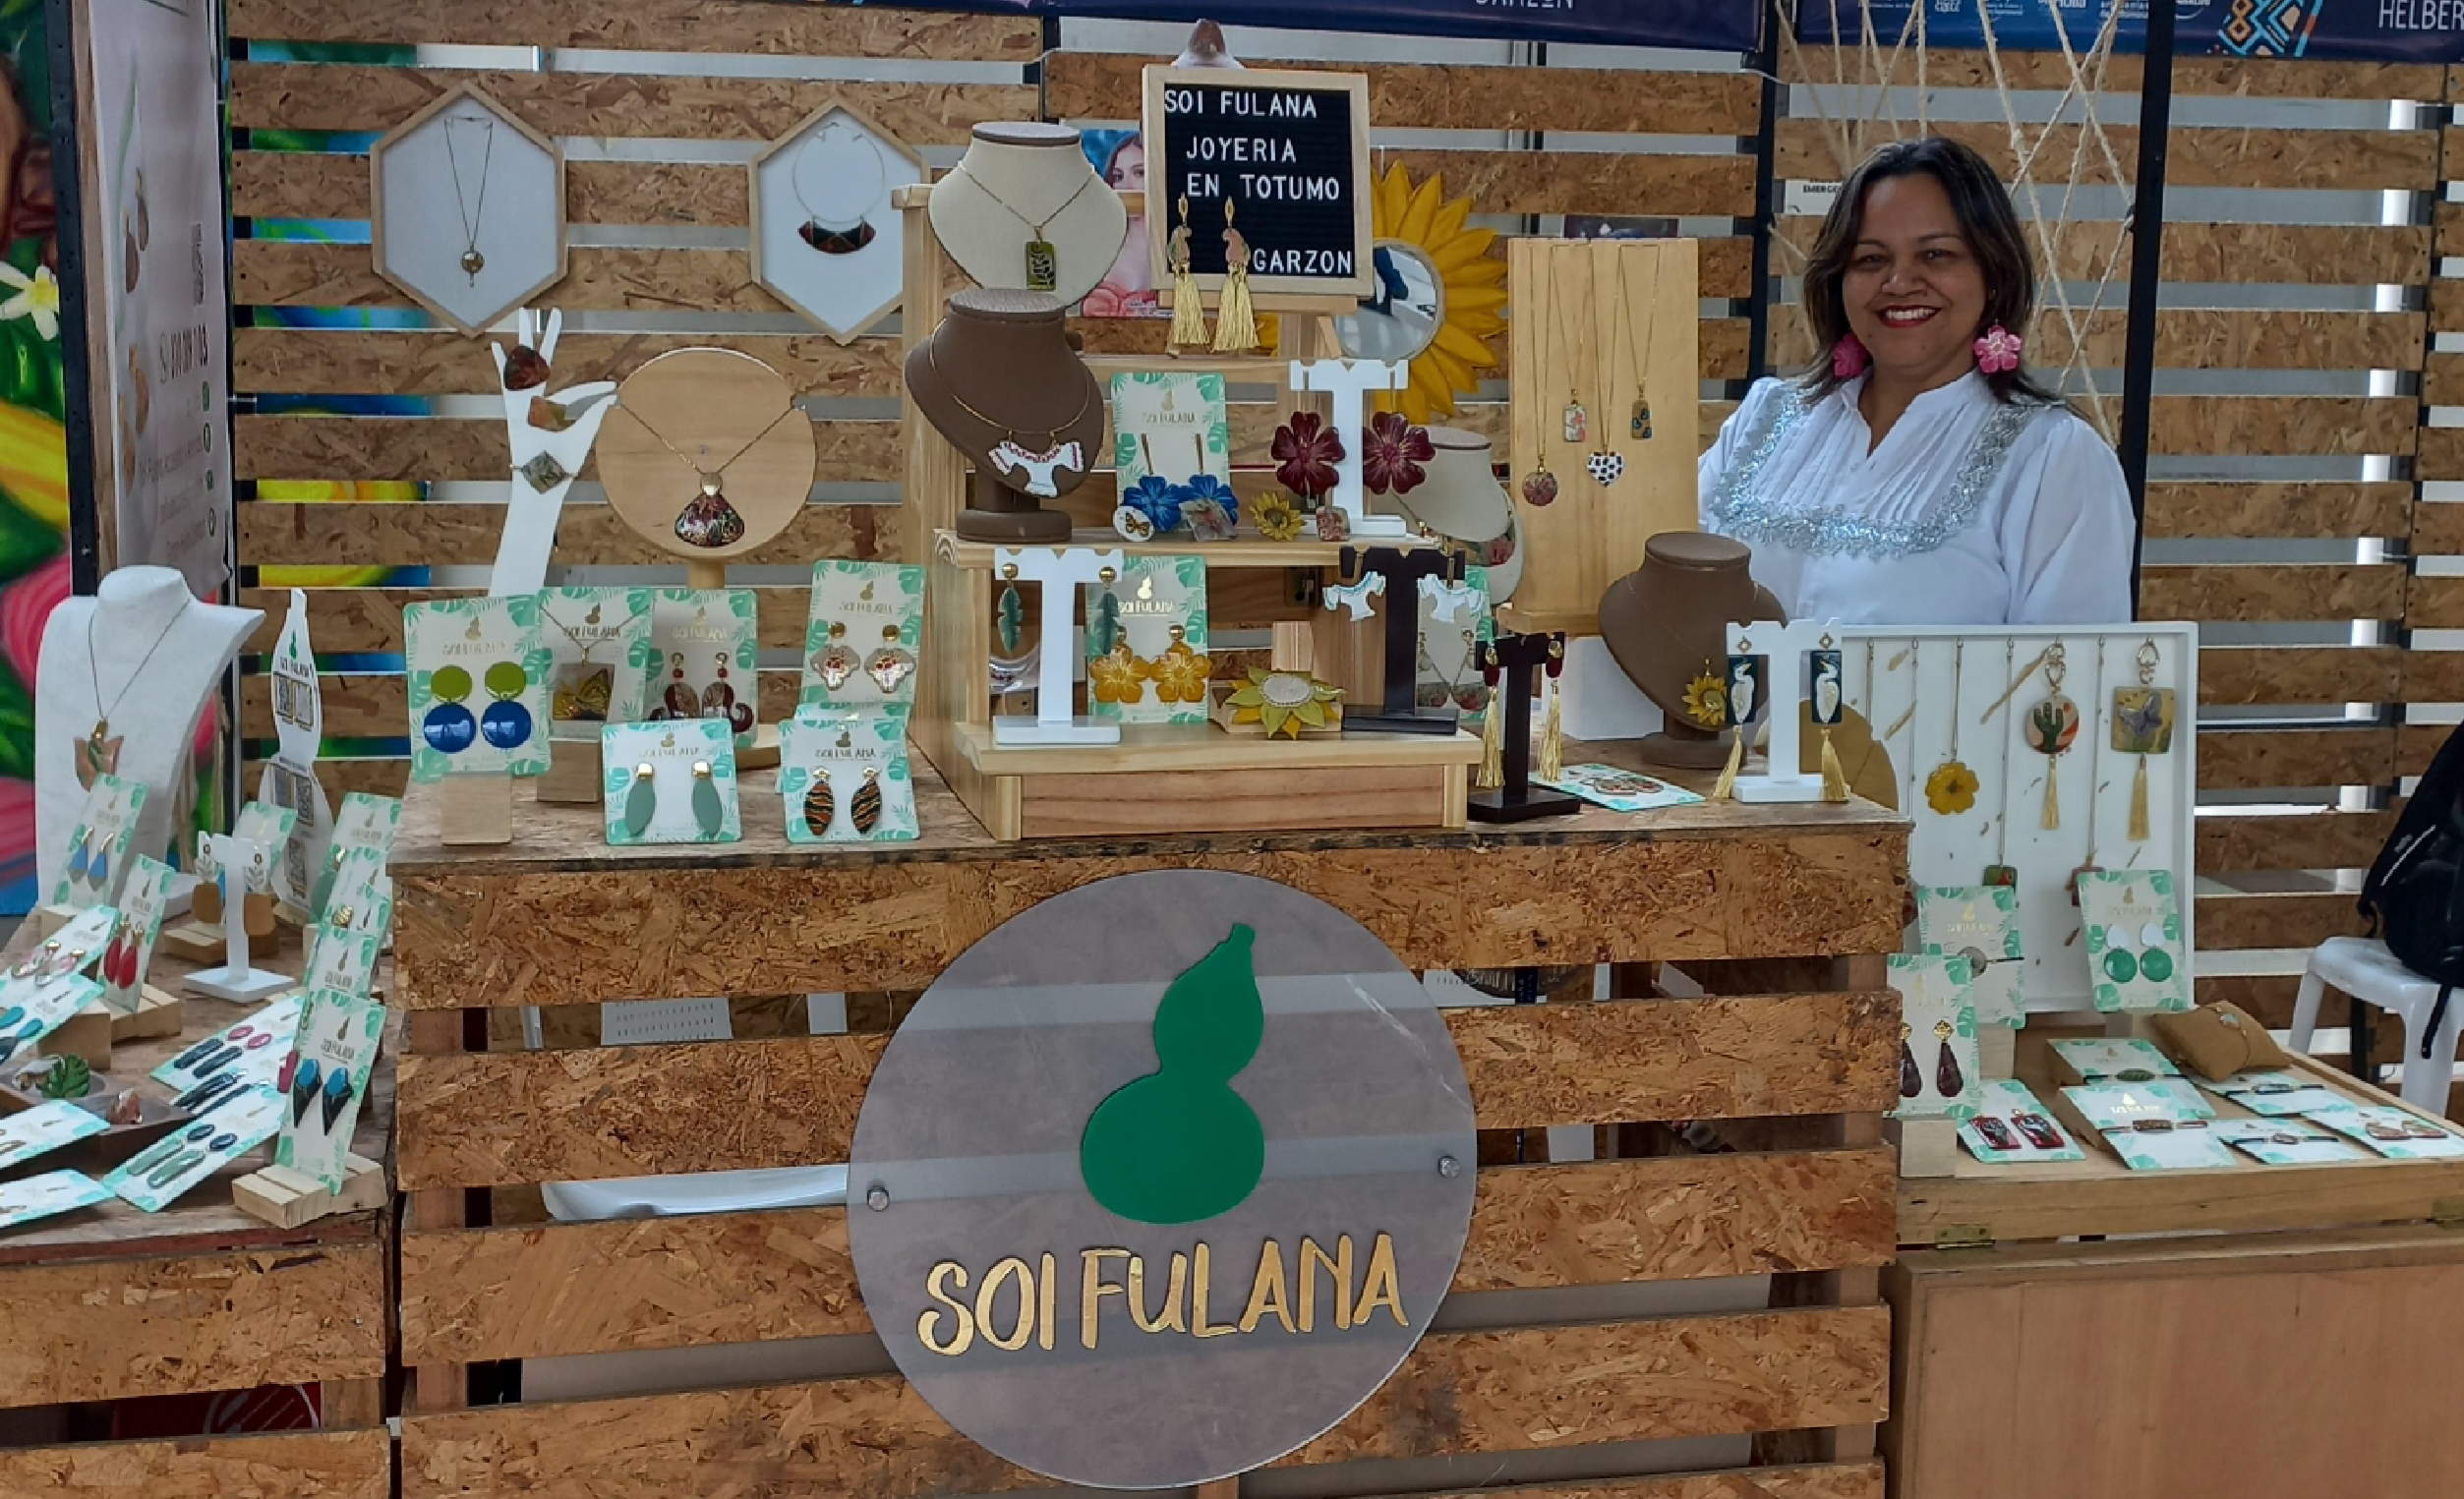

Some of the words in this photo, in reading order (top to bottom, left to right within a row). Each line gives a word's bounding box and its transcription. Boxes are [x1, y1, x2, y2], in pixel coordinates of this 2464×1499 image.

[1164, 89, 1203, 114] SOI
[1220, 90, 1318, 118] FULANA
[1186, 136, 1297, 163] JOYERIA
[1187, 173, 1219, 198] EN
[1239, 174, 1340, 201] TOTUMO
[1253, 249, 1353, 274] GARZON
[916, 1251, 1056, 1356] SOI
[1080, 1231, 1410, 1352] FULANA
